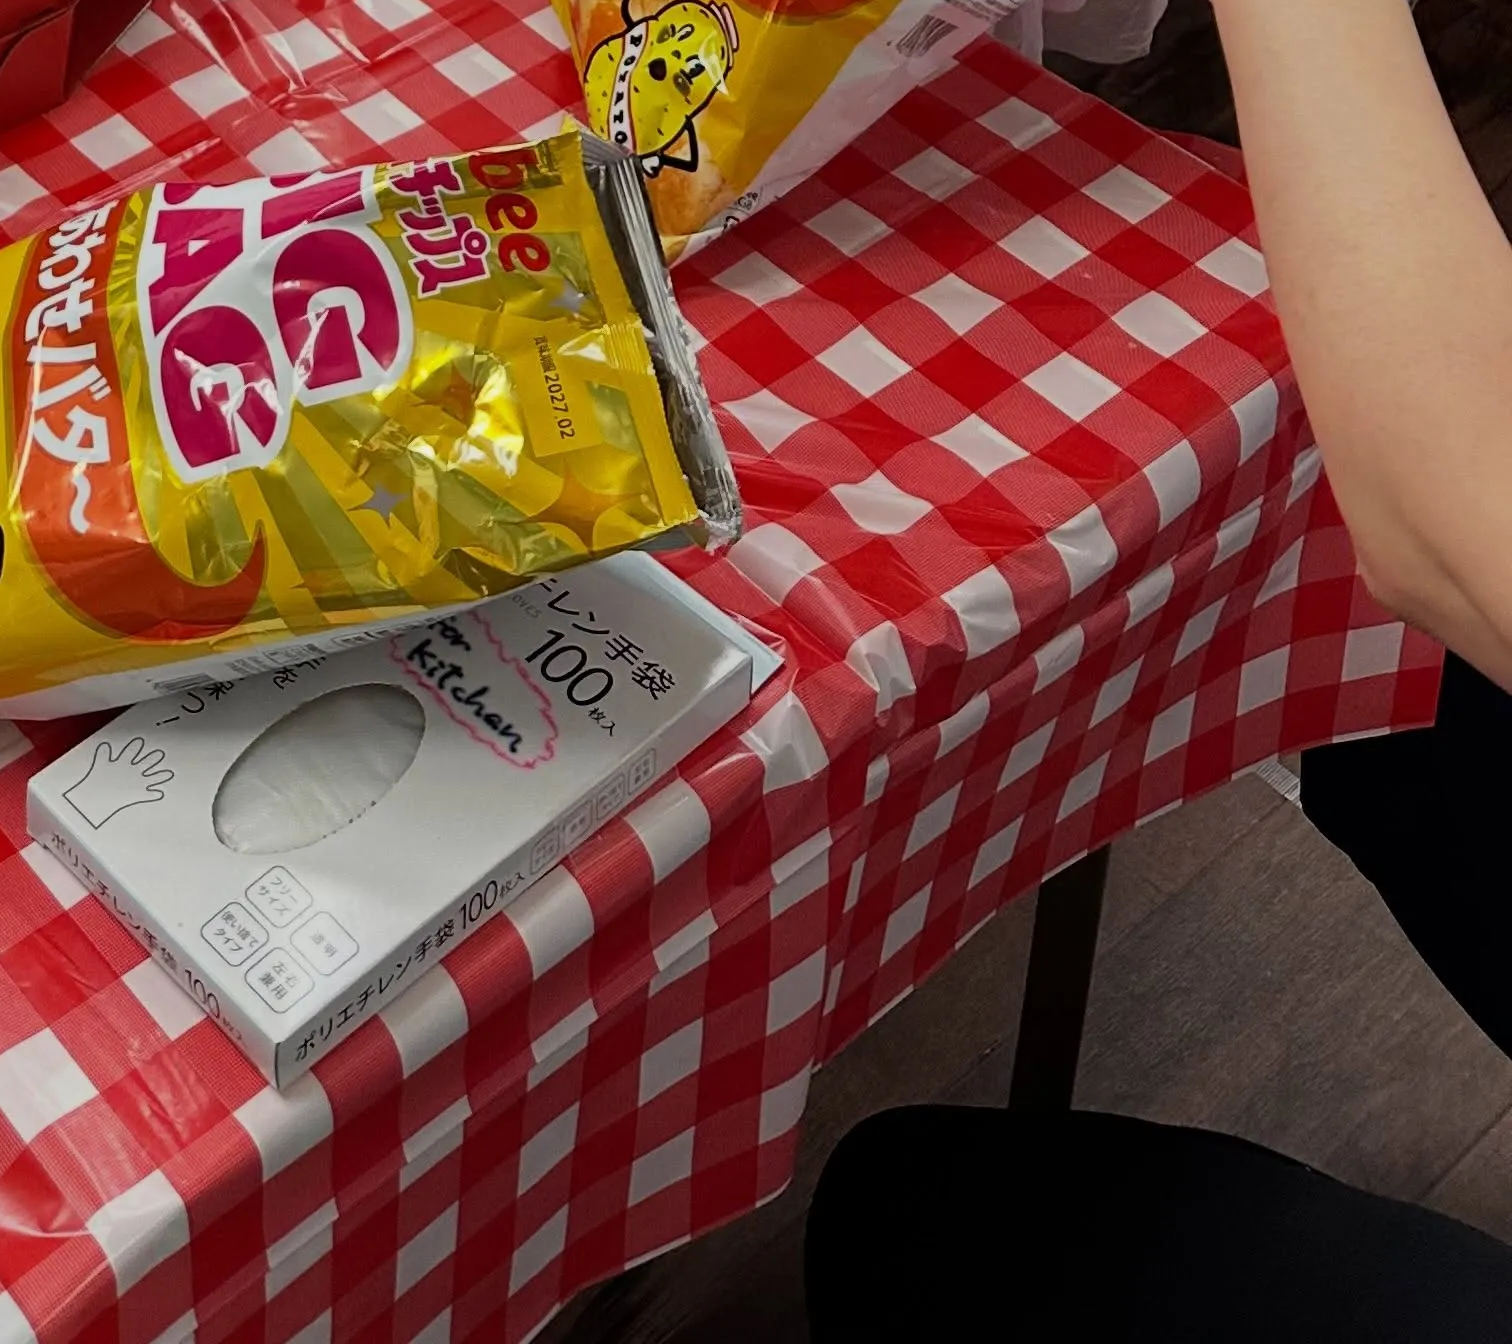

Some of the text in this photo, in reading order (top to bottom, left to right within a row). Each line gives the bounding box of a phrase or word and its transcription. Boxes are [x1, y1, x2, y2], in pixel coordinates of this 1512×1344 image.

[612, 33, 643, 145] POTATO
[261, 155, 401, 391] IG
[295, 918, 455, 1062] ポリエチレン手袋
